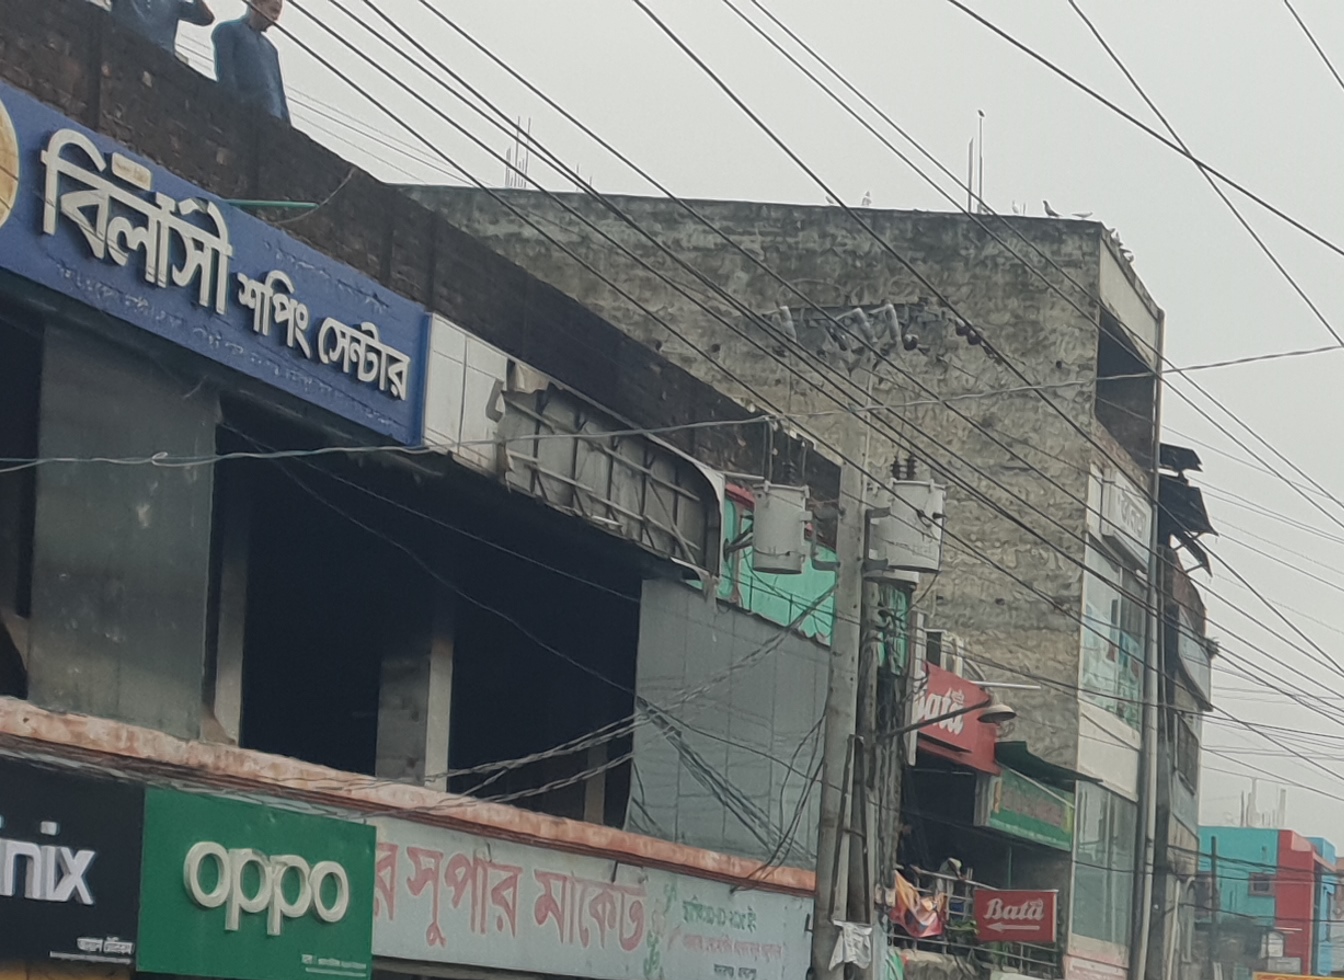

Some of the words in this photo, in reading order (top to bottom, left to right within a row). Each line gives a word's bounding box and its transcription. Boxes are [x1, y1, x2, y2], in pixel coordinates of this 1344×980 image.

[238, 270, 311, 358] শপিং
[318, 316, 411, 401] সেন্টার
[184, 841, 349, 936] oppo
[406, 846, 523, 947] সুপার
[983, 898, 1044, 922] Bata
